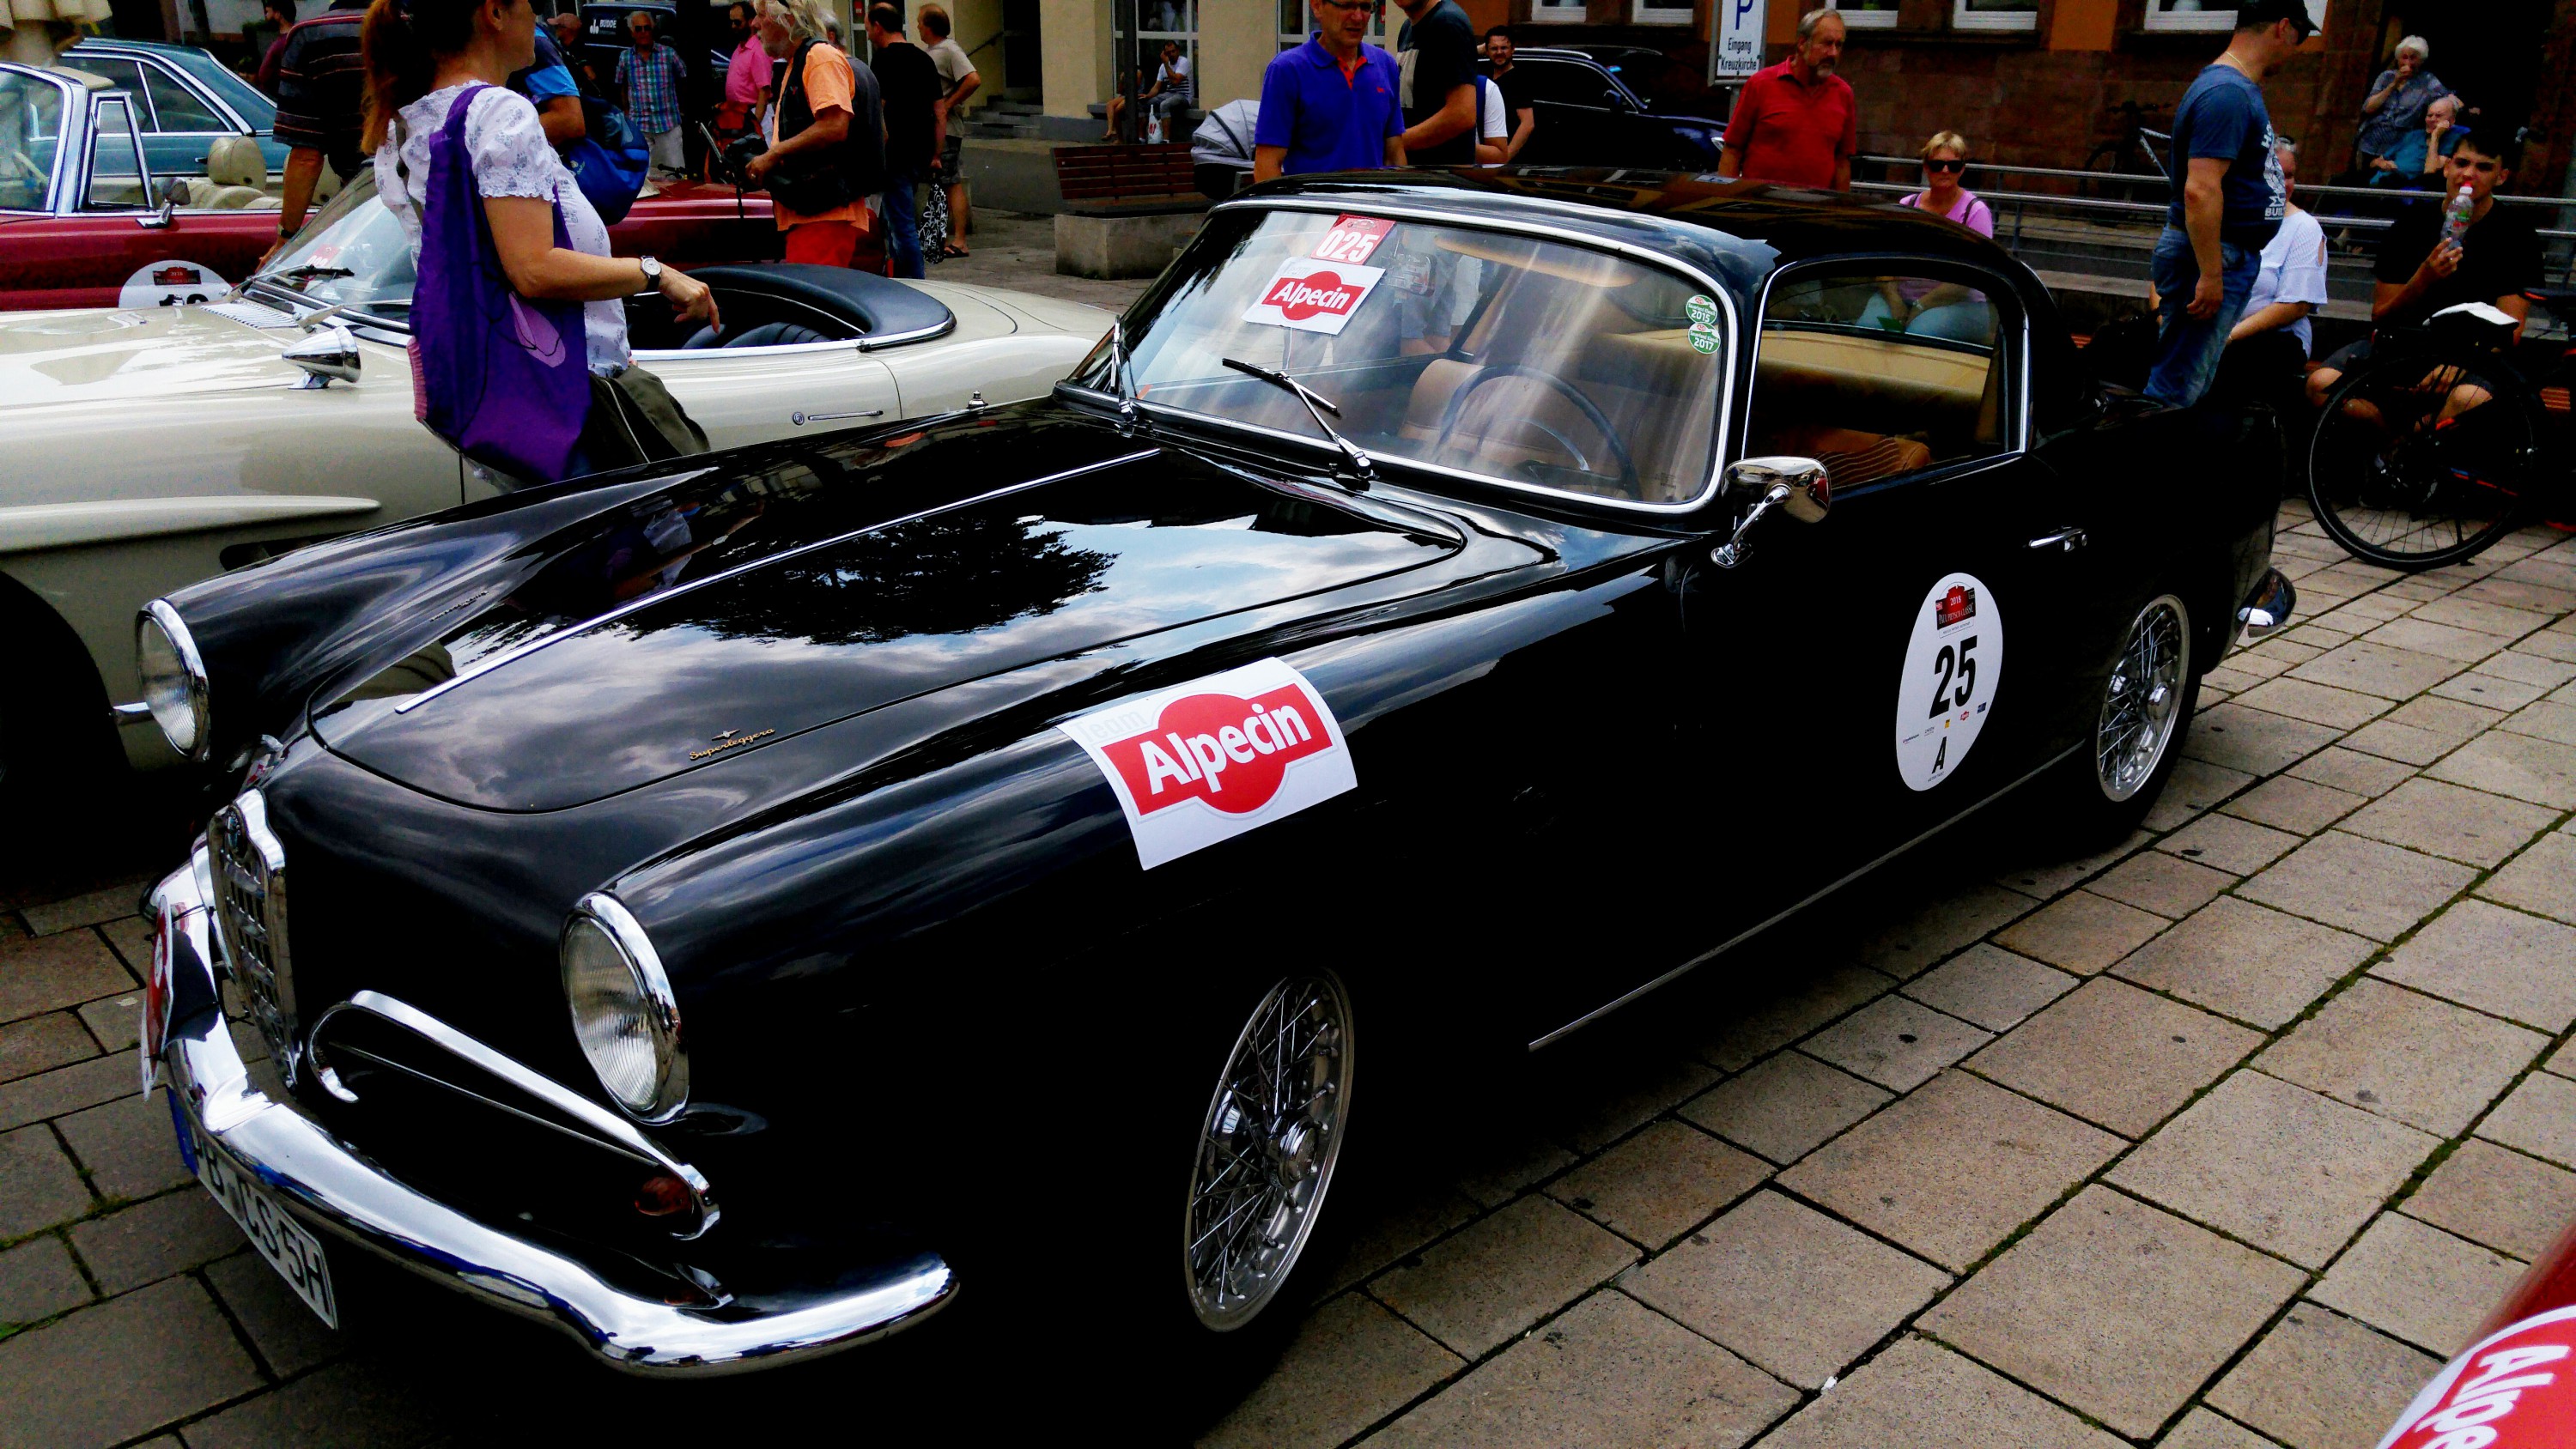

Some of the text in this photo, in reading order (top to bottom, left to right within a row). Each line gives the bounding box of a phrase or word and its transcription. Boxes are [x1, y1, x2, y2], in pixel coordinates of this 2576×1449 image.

[1735, 0, 1753, 30] P
[1728, 37, 1752, 54] Eingang
[1721, 56, 1757, 70] Kreuzkirche
[1315, 229, 1378, 263] 025
[1272, 281, 1351, 310] Alpecin
[1691, 310, 1710, 323] 2015
[1694, 338, 1714, 351] 2017
[1950, 595, 1962, 606] 2018
[1929, 634, 1978, 719] 25
[1074, 710, 1147, 743] Team
[690, 728, 775, 760] Superleggera
[1139, 703, 1312, 795] Alpecin
[1931, 736, 1947, 774] A
